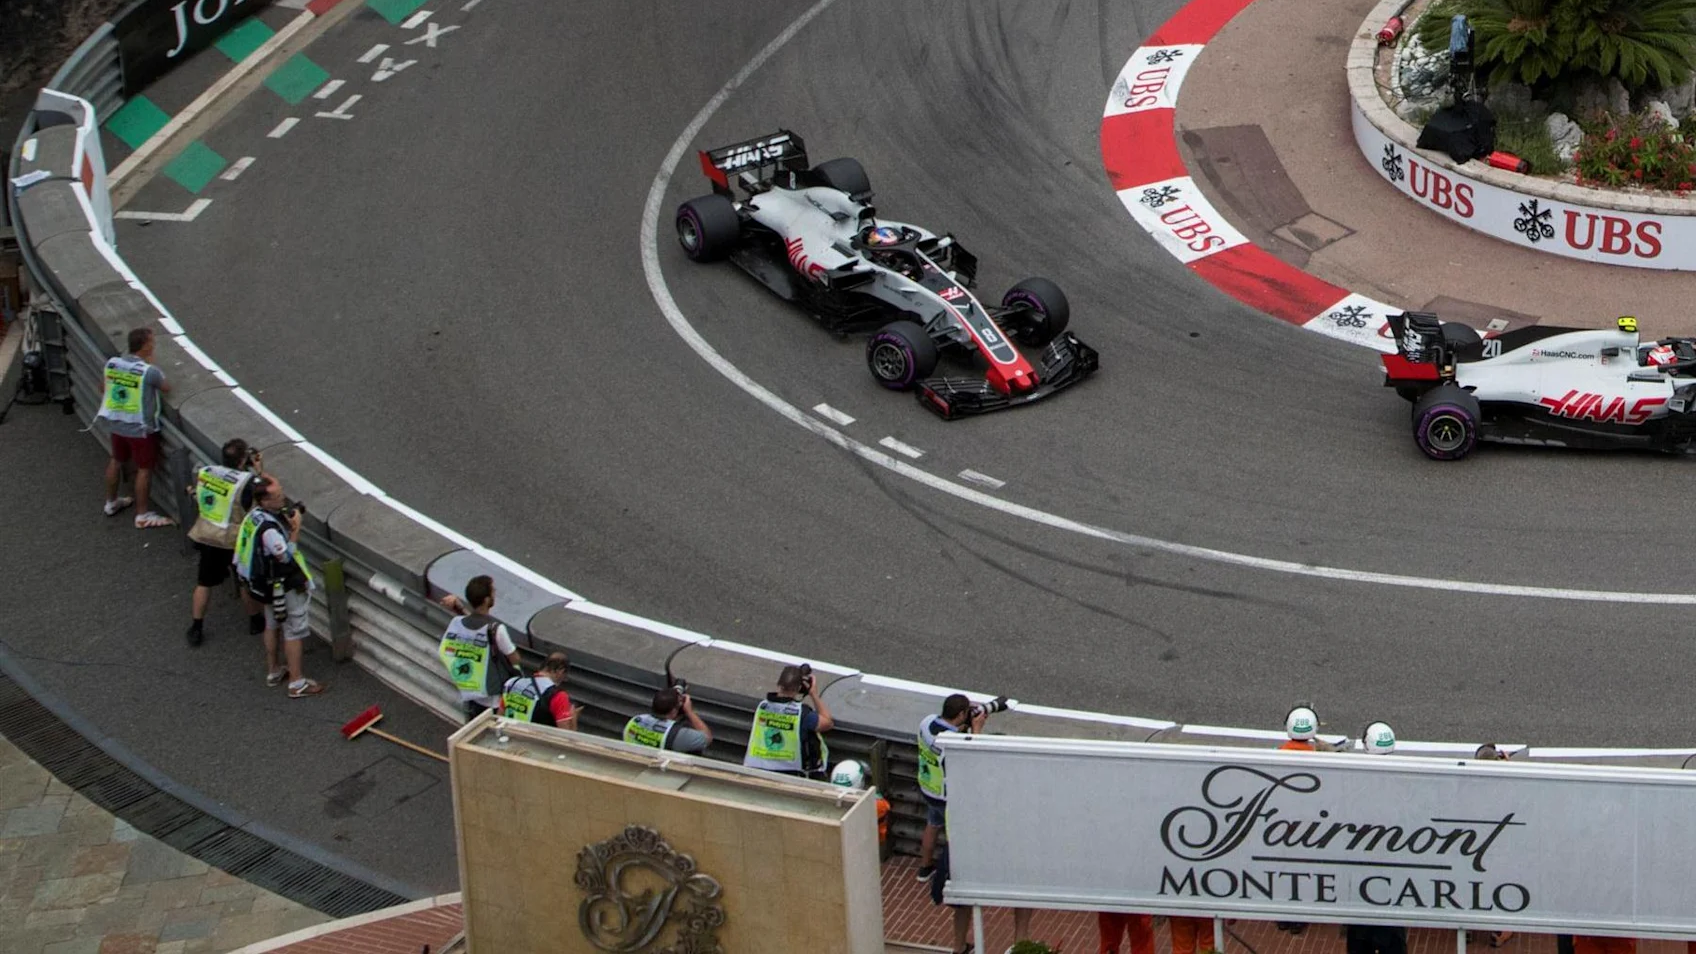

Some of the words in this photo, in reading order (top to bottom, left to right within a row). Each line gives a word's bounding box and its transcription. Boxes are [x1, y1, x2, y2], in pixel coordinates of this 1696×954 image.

[1124, 66, 1173, 109] UBS
[1409, 160, 1474, 218] UBS
[1160, 204, 1226, 253] UBS
[1564, 210, 1663, 259] UBS
[1482, 339, 1501, 358] 20
[1539, 389, 1668, 426] HAAS
[1160, 765, 1528, 873] Fairmont
[1157, 865, 1338, 904] MONTE
[1358, 875, 1532, 913] CARLO
